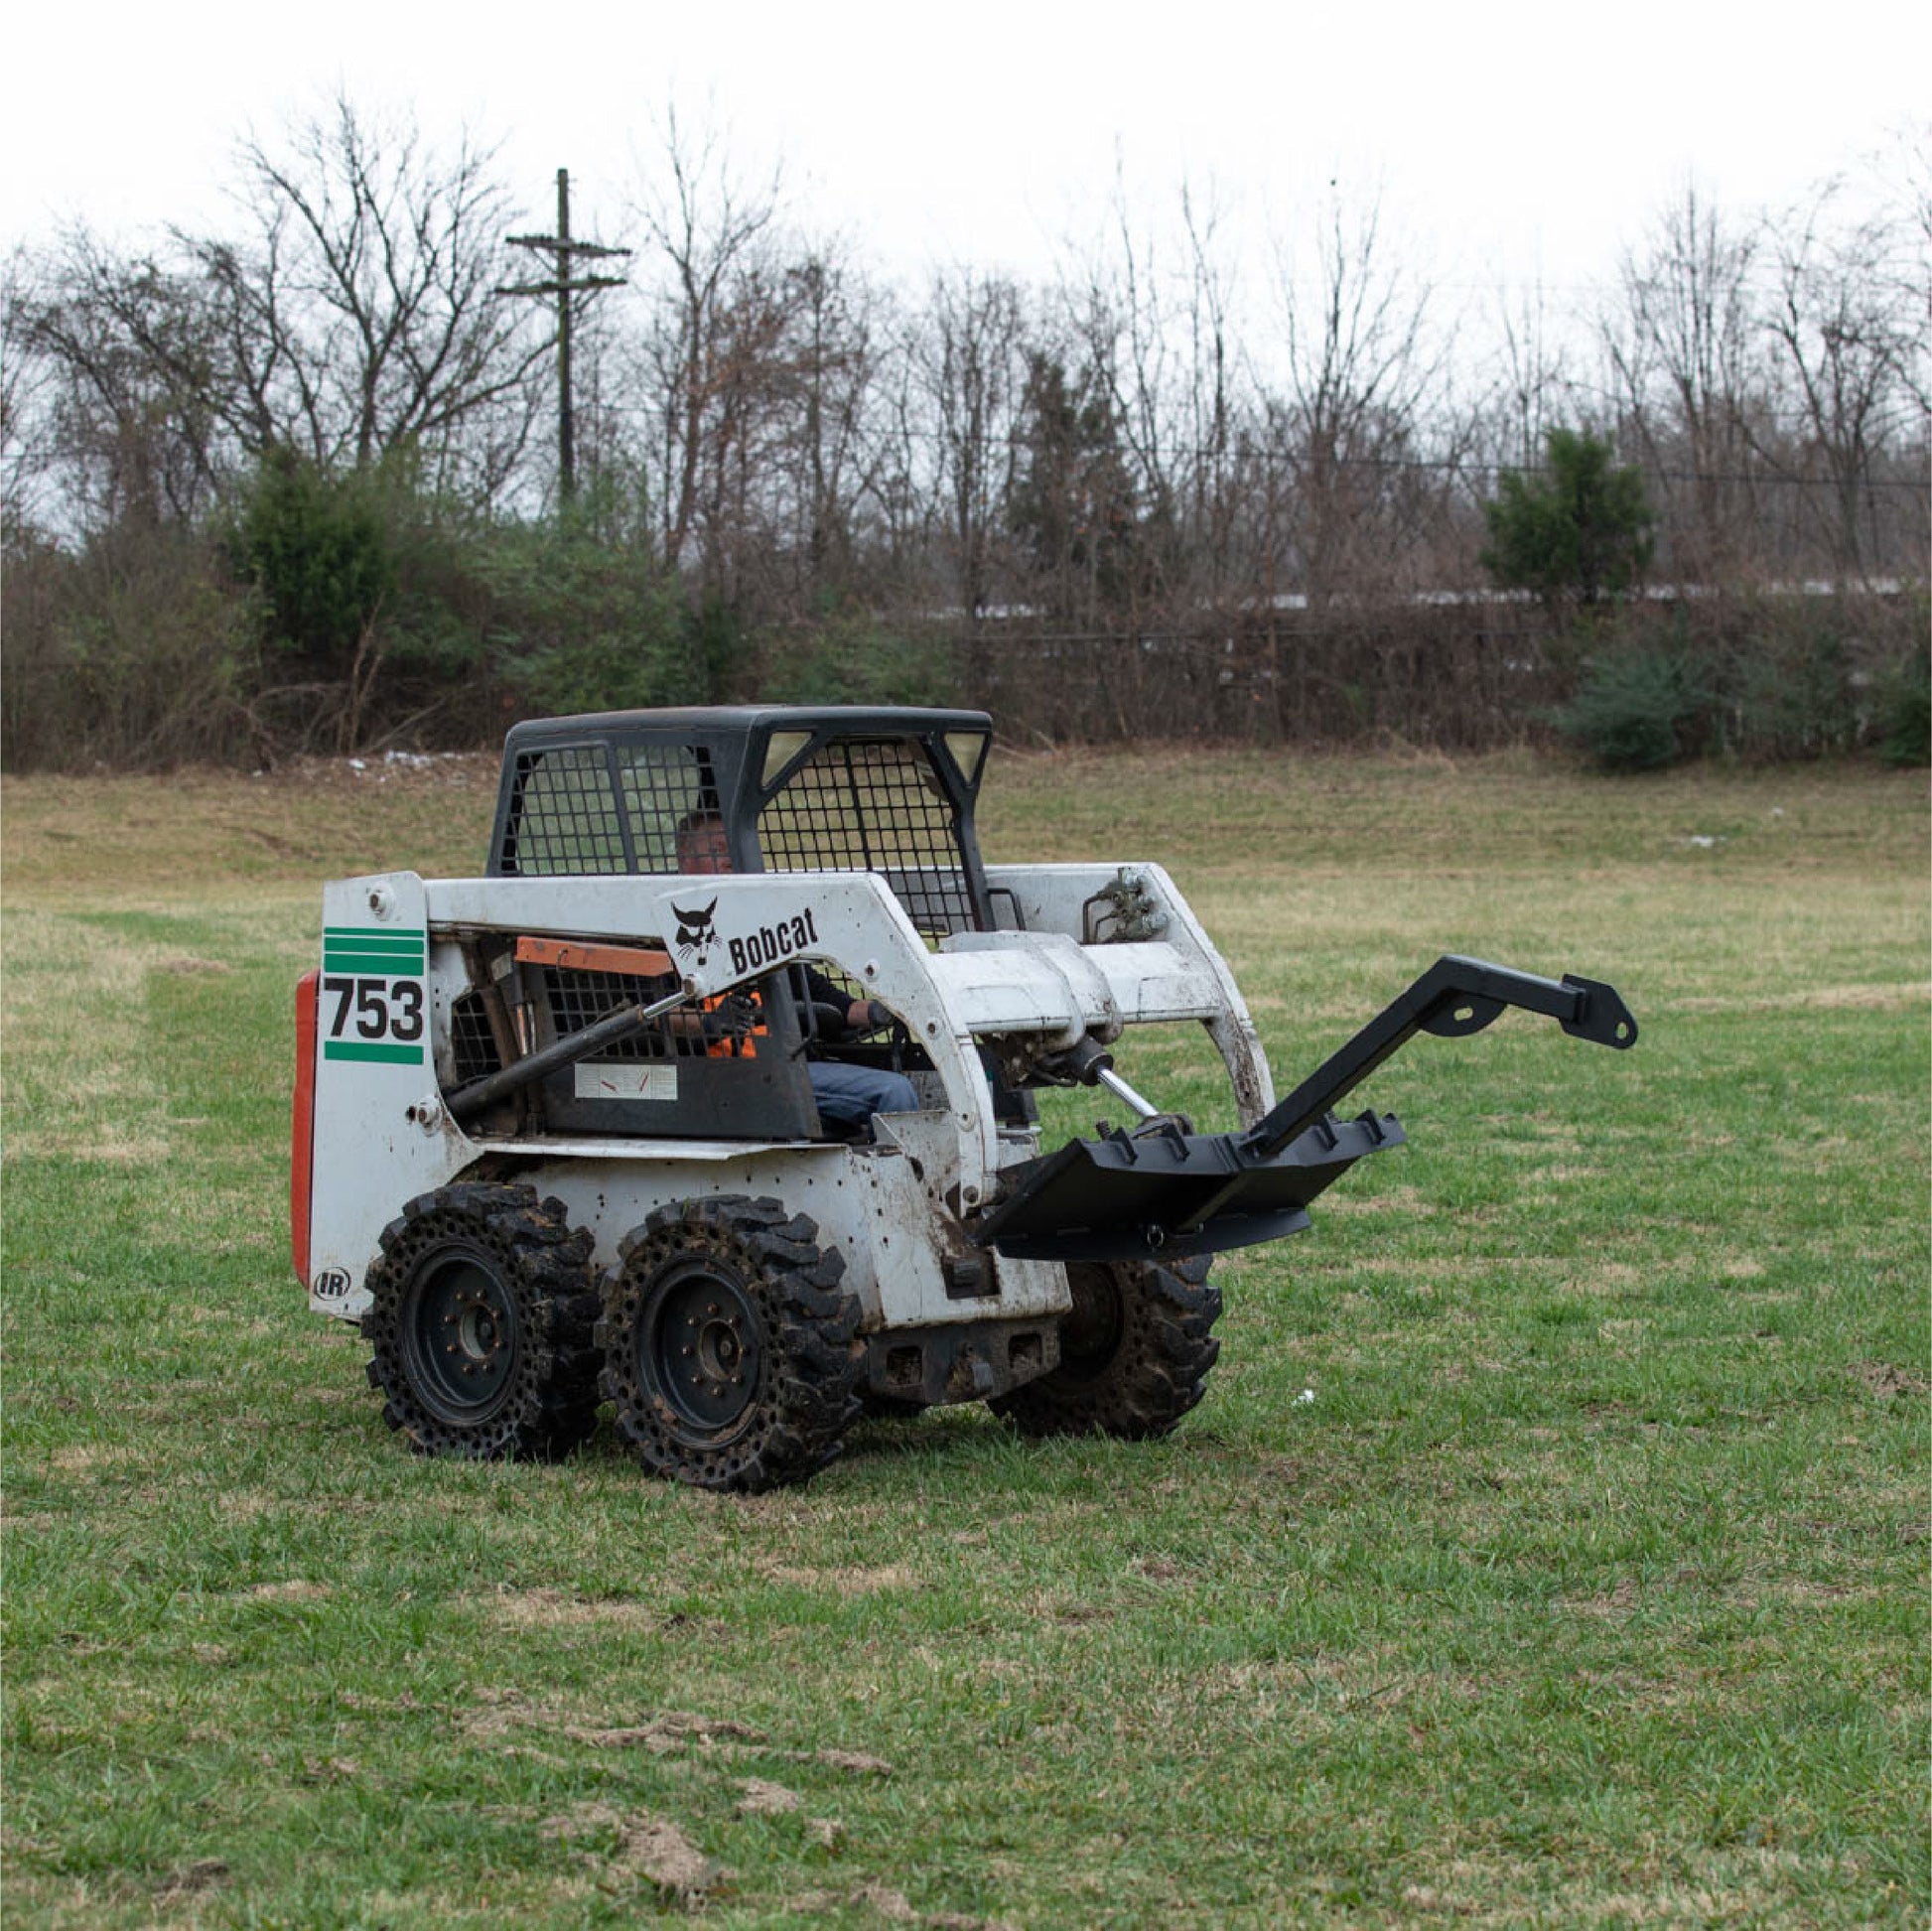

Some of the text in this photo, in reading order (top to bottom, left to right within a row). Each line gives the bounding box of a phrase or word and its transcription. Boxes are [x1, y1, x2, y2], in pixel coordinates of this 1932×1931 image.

[729, 907, 818, 976] Bobcat
[324, 978, 423, 1041] 753
[320, 1272, 345, 1297] IR
